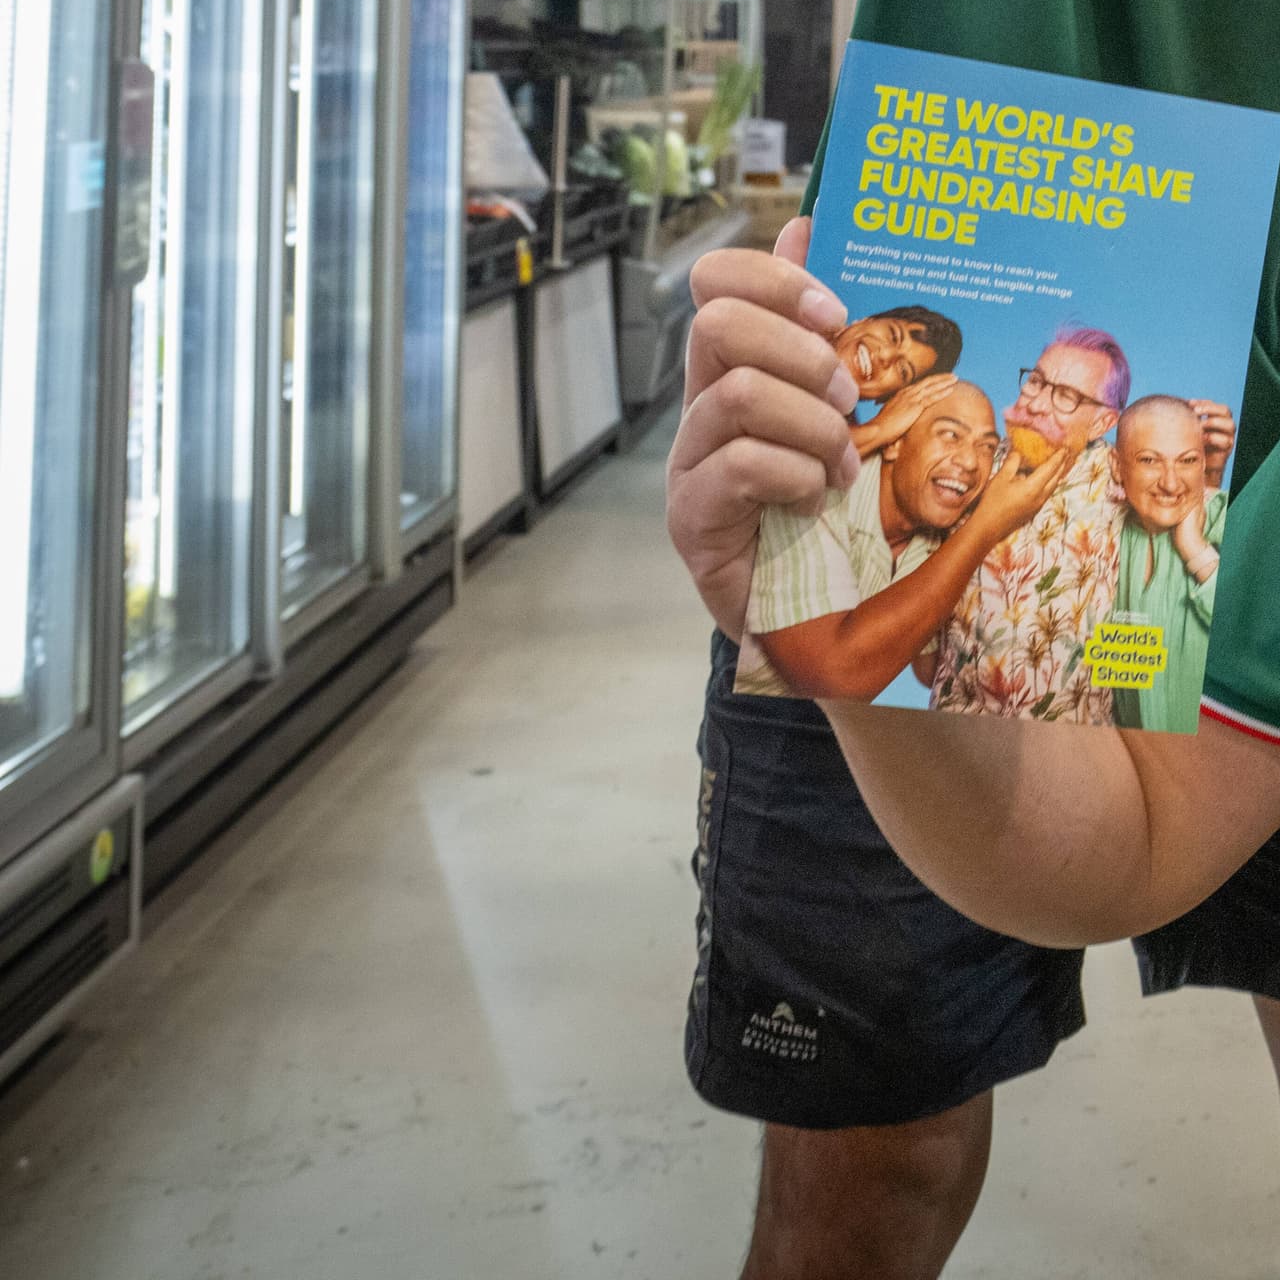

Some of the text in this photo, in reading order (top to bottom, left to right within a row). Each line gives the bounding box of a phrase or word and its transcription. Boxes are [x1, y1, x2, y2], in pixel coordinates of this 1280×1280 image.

[874, 84, 1135, 157] THE WORLD'S
[866, 123, 1194, 203] GREATEST SHAVE
[859, 160, 1126, 229] FUNDRAISING
[853, 198, 979, 246] GUIDE
[843, 256, 1073, 299] fundraising goal and fuel real, tangible change
[846, 240, 1058, 280] Everything you need to know to reach your
[841, 271, 1014, 304] for Australians facing blood cancer
[1089, 645, 1162, 666] Greatest
[1101, 628, 1158, 646] World's
[1097, 666, 1149, 683] Shave
[751, 1013, 817, 1040] ANTHEM
